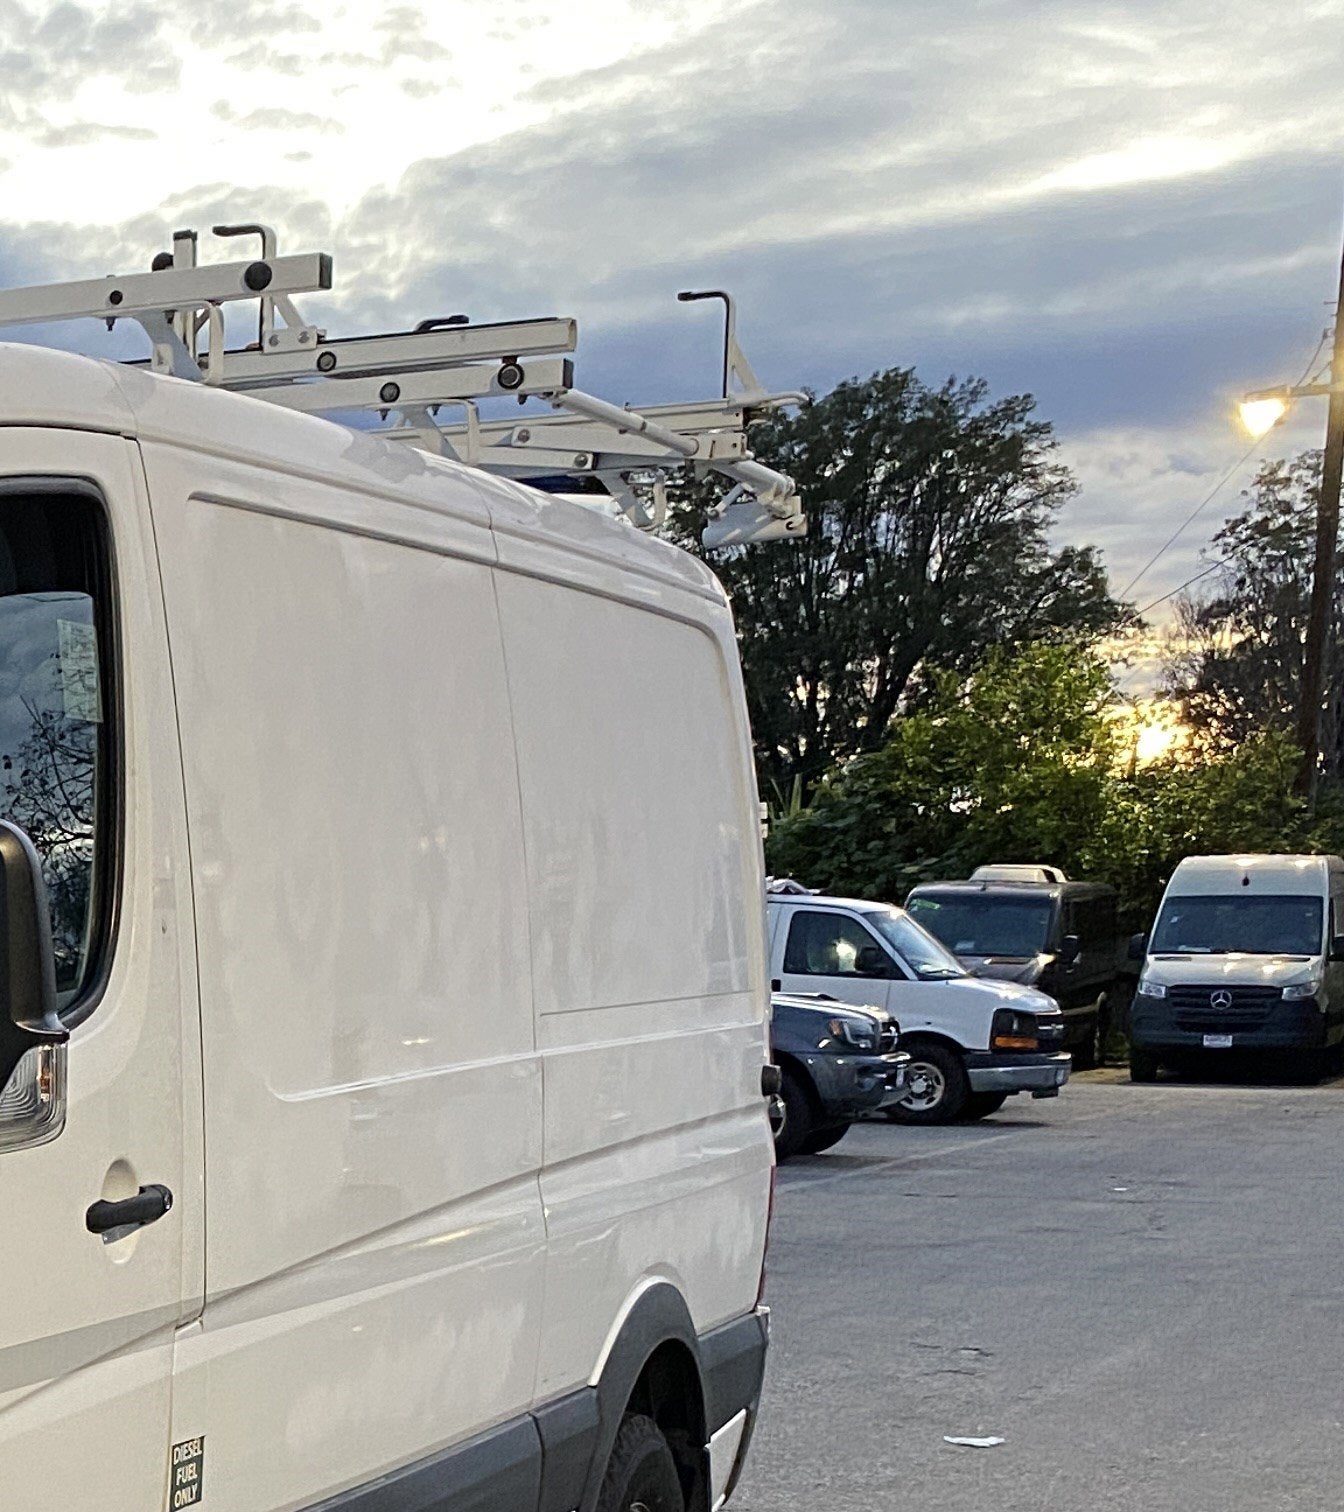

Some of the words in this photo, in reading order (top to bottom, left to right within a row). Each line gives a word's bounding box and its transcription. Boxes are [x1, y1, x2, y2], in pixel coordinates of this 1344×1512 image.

[173, 1439, 203, 1465] DIESEL
[176, 1462, 198, 1486] FUEL
[174, 1483, 198, 1508] ONLY
